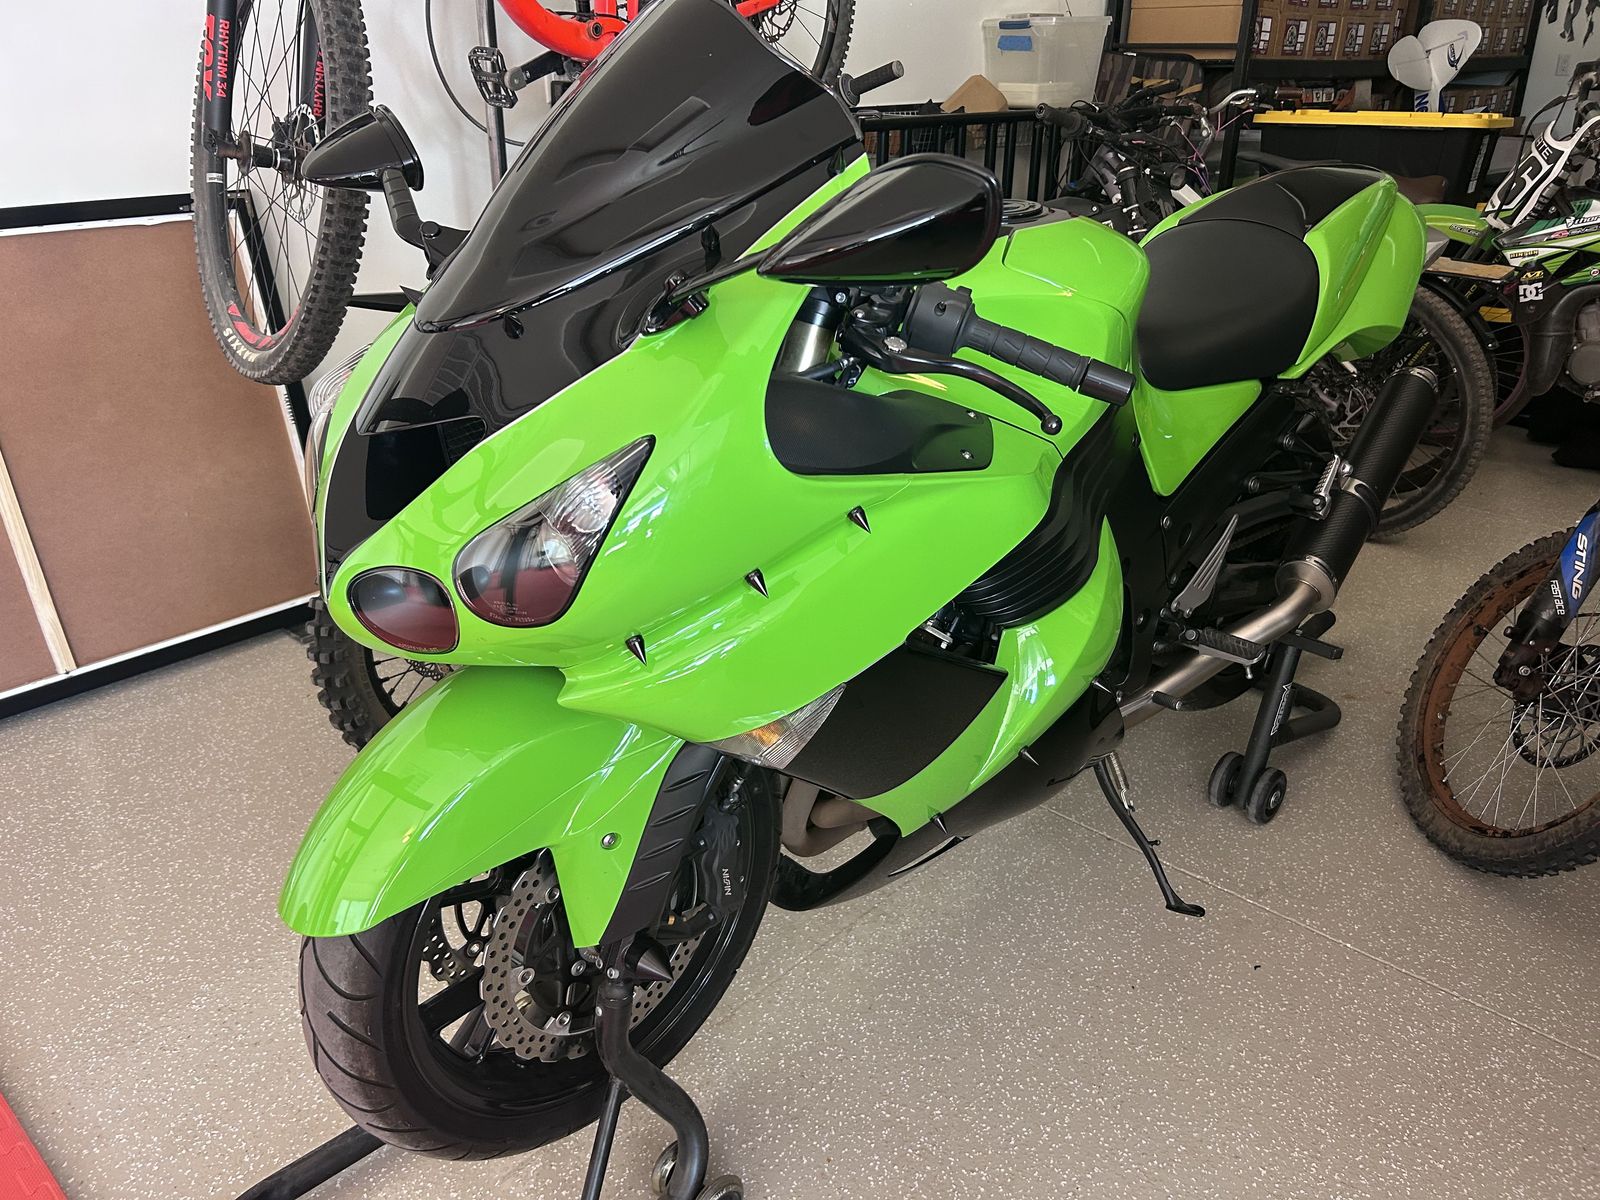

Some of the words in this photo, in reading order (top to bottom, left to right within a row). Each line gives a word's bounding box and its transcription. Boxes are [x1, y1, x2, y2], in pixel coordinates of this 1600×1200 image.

[216, 19, 230, 79] RHYTHM
[216, 80, 228, 98] 34
[1518, 282, 1544, 303] DC
[223, 327, 259, 363] MAXXIS
[1571, 532, 1588, 600] STING
